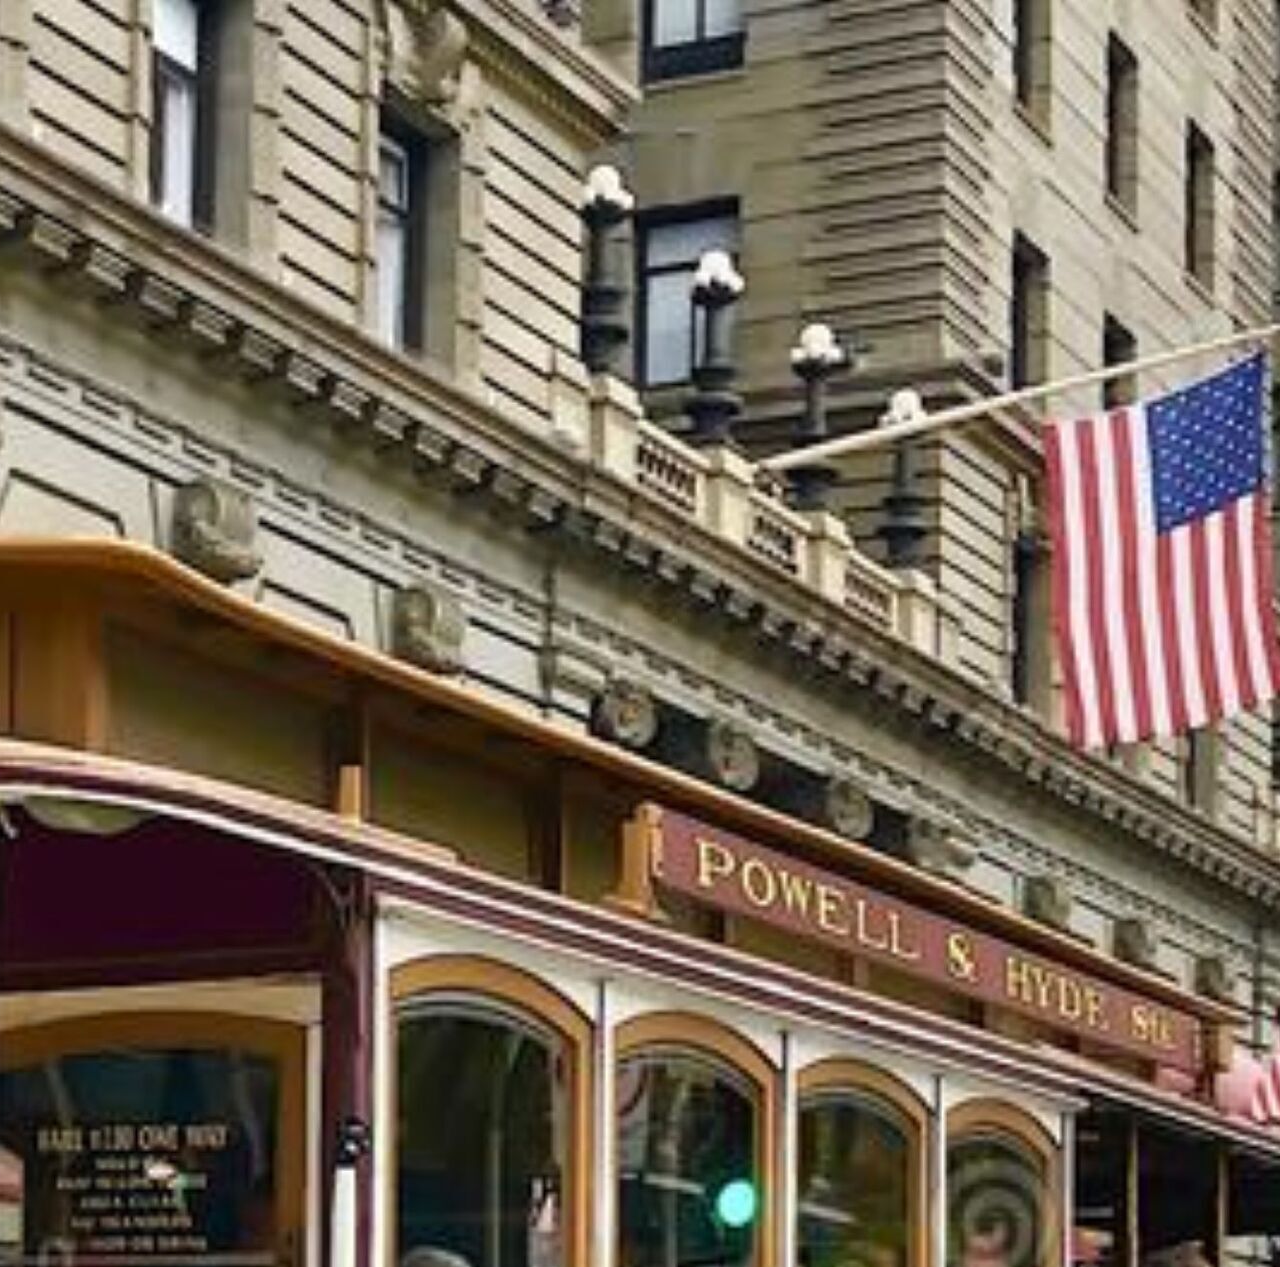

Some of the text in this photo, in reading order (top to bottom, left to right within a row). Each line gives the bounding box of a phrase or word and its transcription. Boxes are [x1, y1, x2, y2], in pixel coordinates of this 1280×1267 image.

[695, 836, 920, 961] POWELL
[945, 932, 977, 982] &
[1005, 955, 1110, 1032] HYDE
